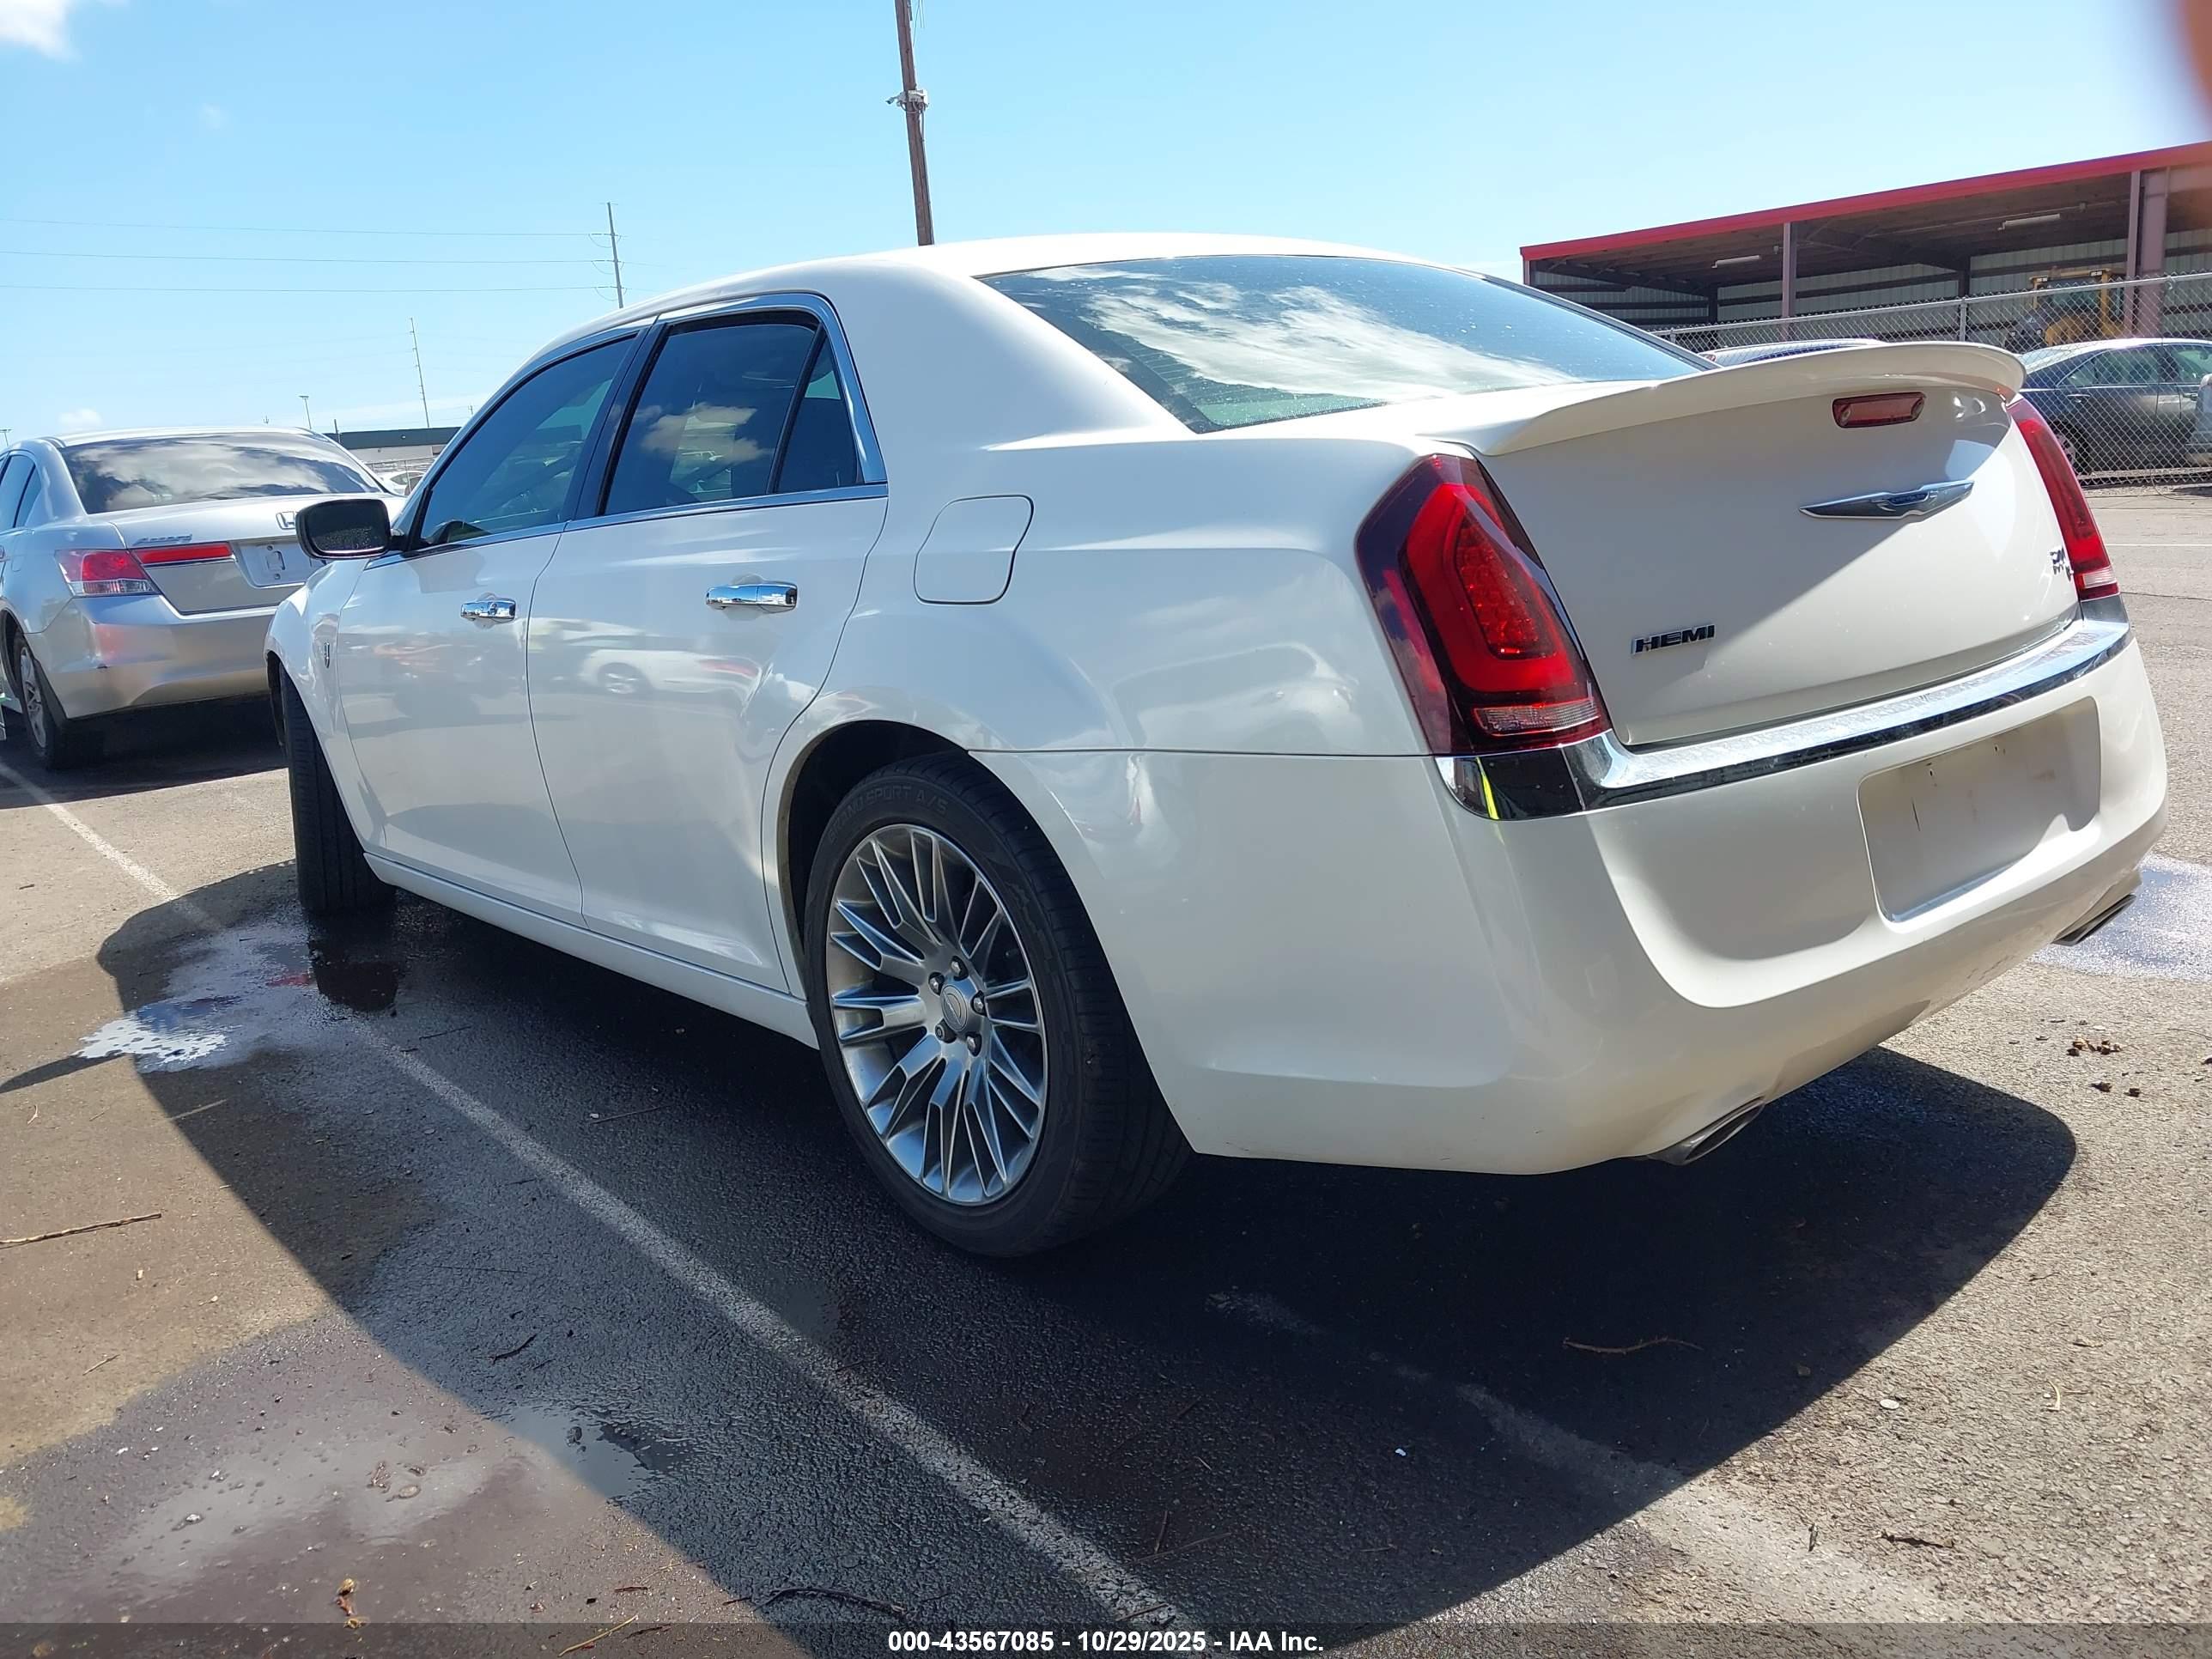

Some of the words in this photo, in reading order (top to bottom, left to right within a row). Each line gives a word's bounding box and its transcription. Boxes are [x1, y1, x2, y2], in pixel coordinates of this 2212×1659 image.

[1631, 624, 1716, 654] HEMI
[866, 786, 912, 805] SPORT
[915, 789, 948, 814] A/S
